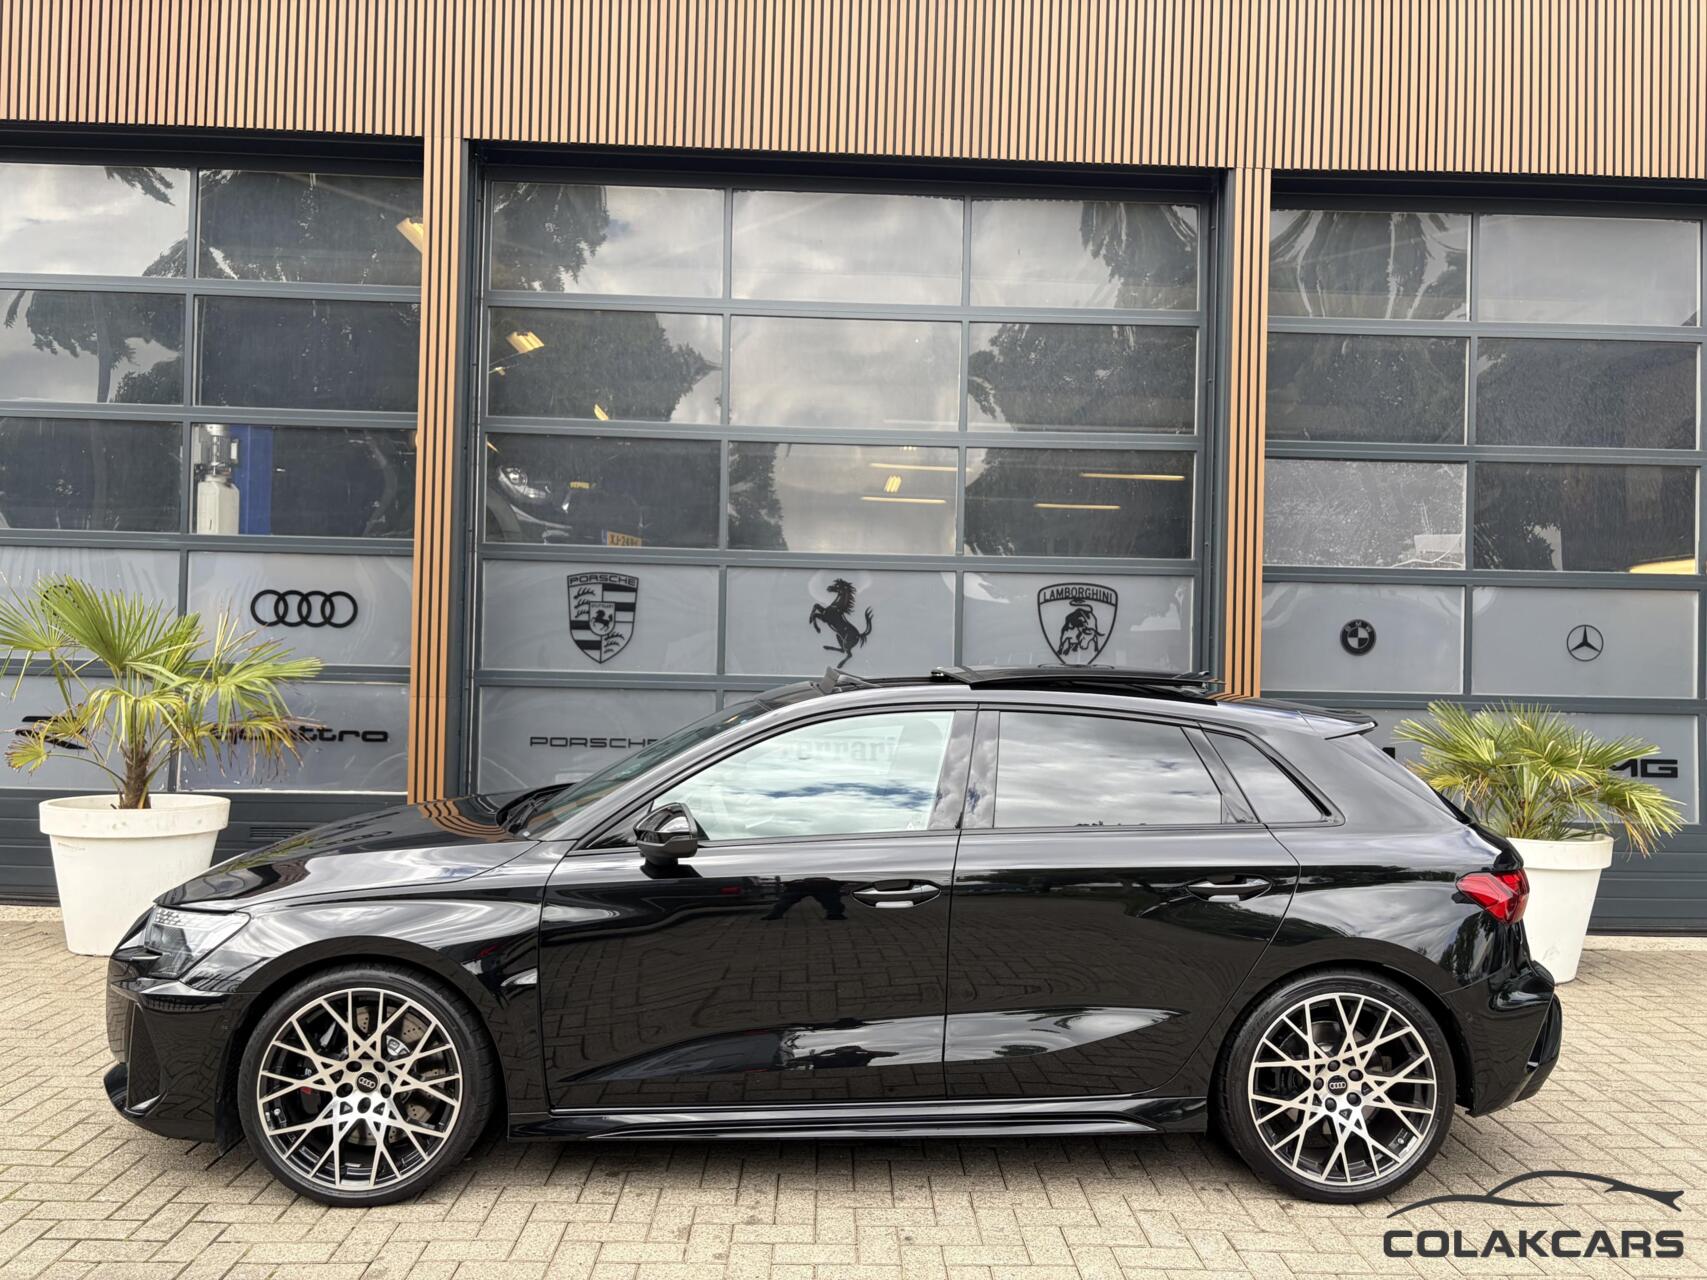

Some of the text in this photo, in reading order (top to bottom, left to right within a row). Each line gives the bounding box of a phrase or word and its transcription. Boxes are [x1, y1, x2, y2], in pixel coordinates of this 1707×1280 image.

[569, 574, 636, 586] PORSCHE
[1043, 587, 1113, 604] LAMBORGHINI
[210, 725, 389, 744] ttro
